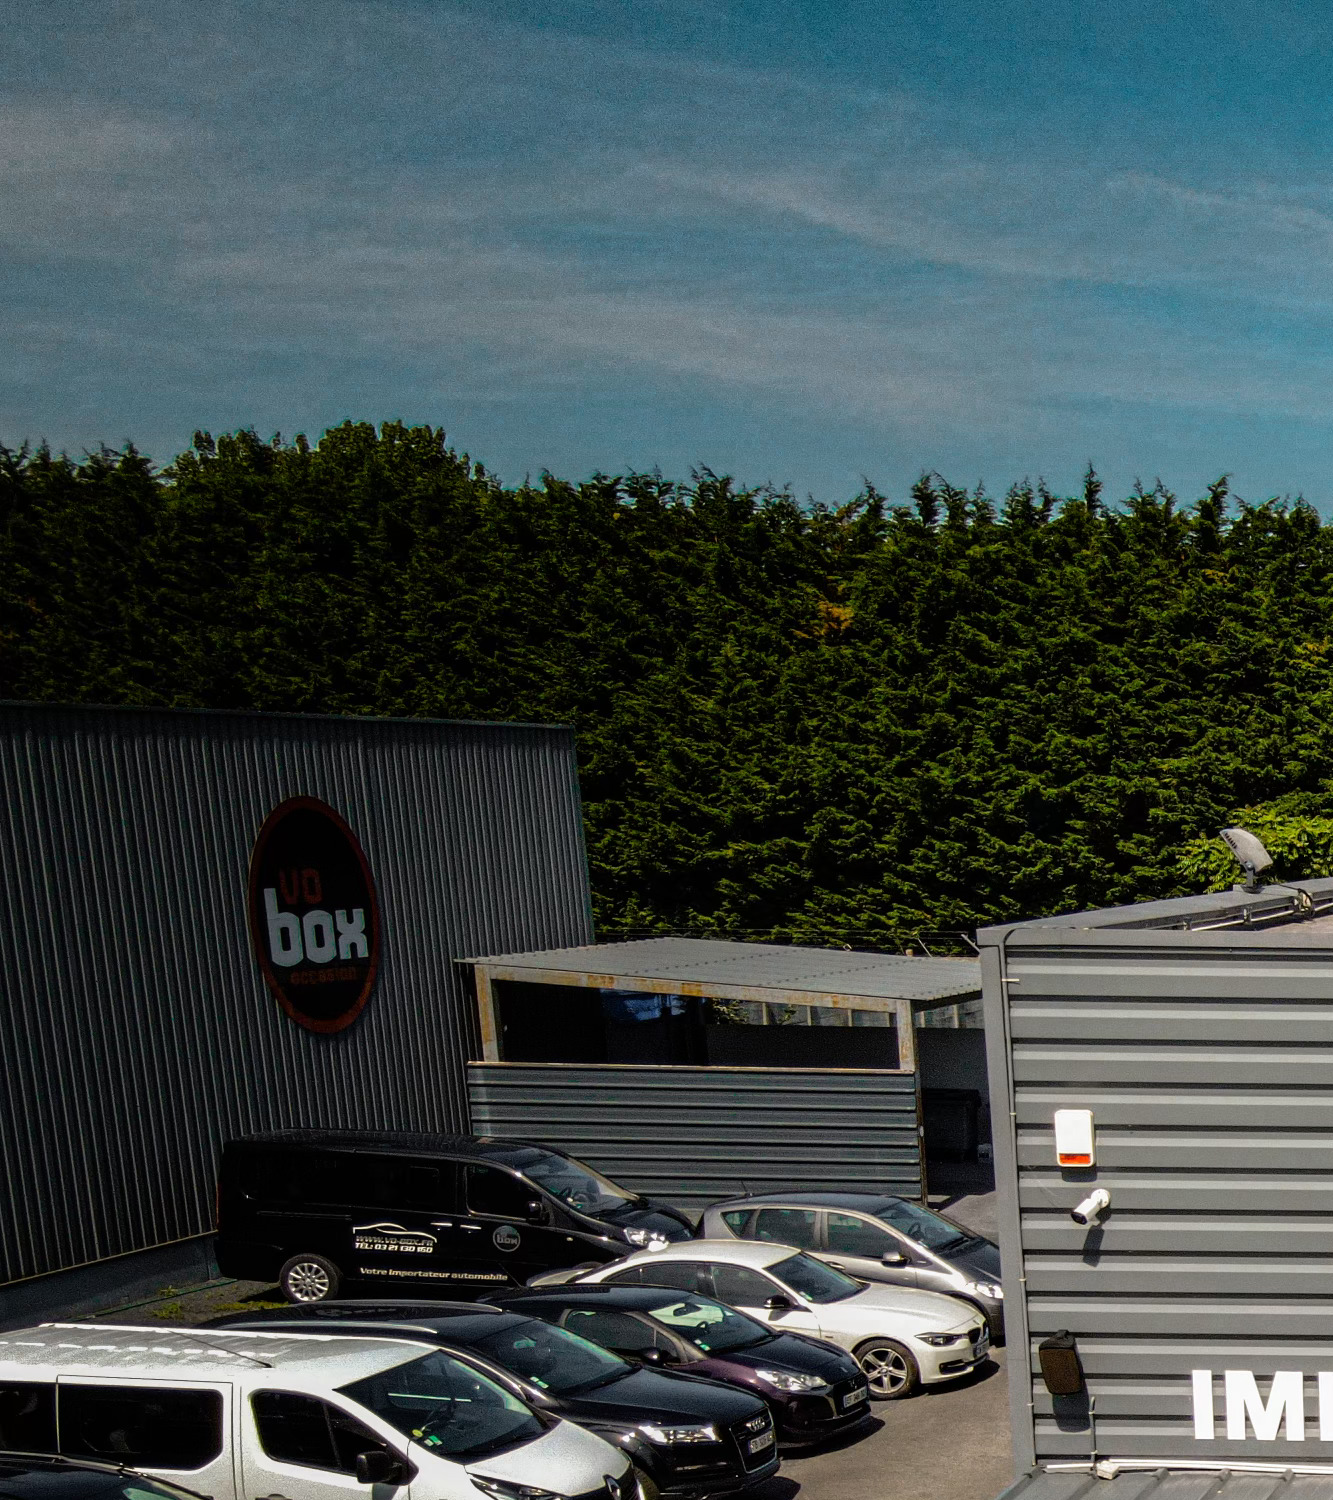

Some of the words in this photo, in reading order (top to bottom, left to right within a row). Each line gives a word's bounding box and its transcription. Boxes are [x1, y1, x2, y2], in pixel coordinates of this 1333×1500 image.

[264, 887, 369, 967] box
[360, 1267, 388, 1276] Votre
[451, 1271, 508, 1281] automobile
